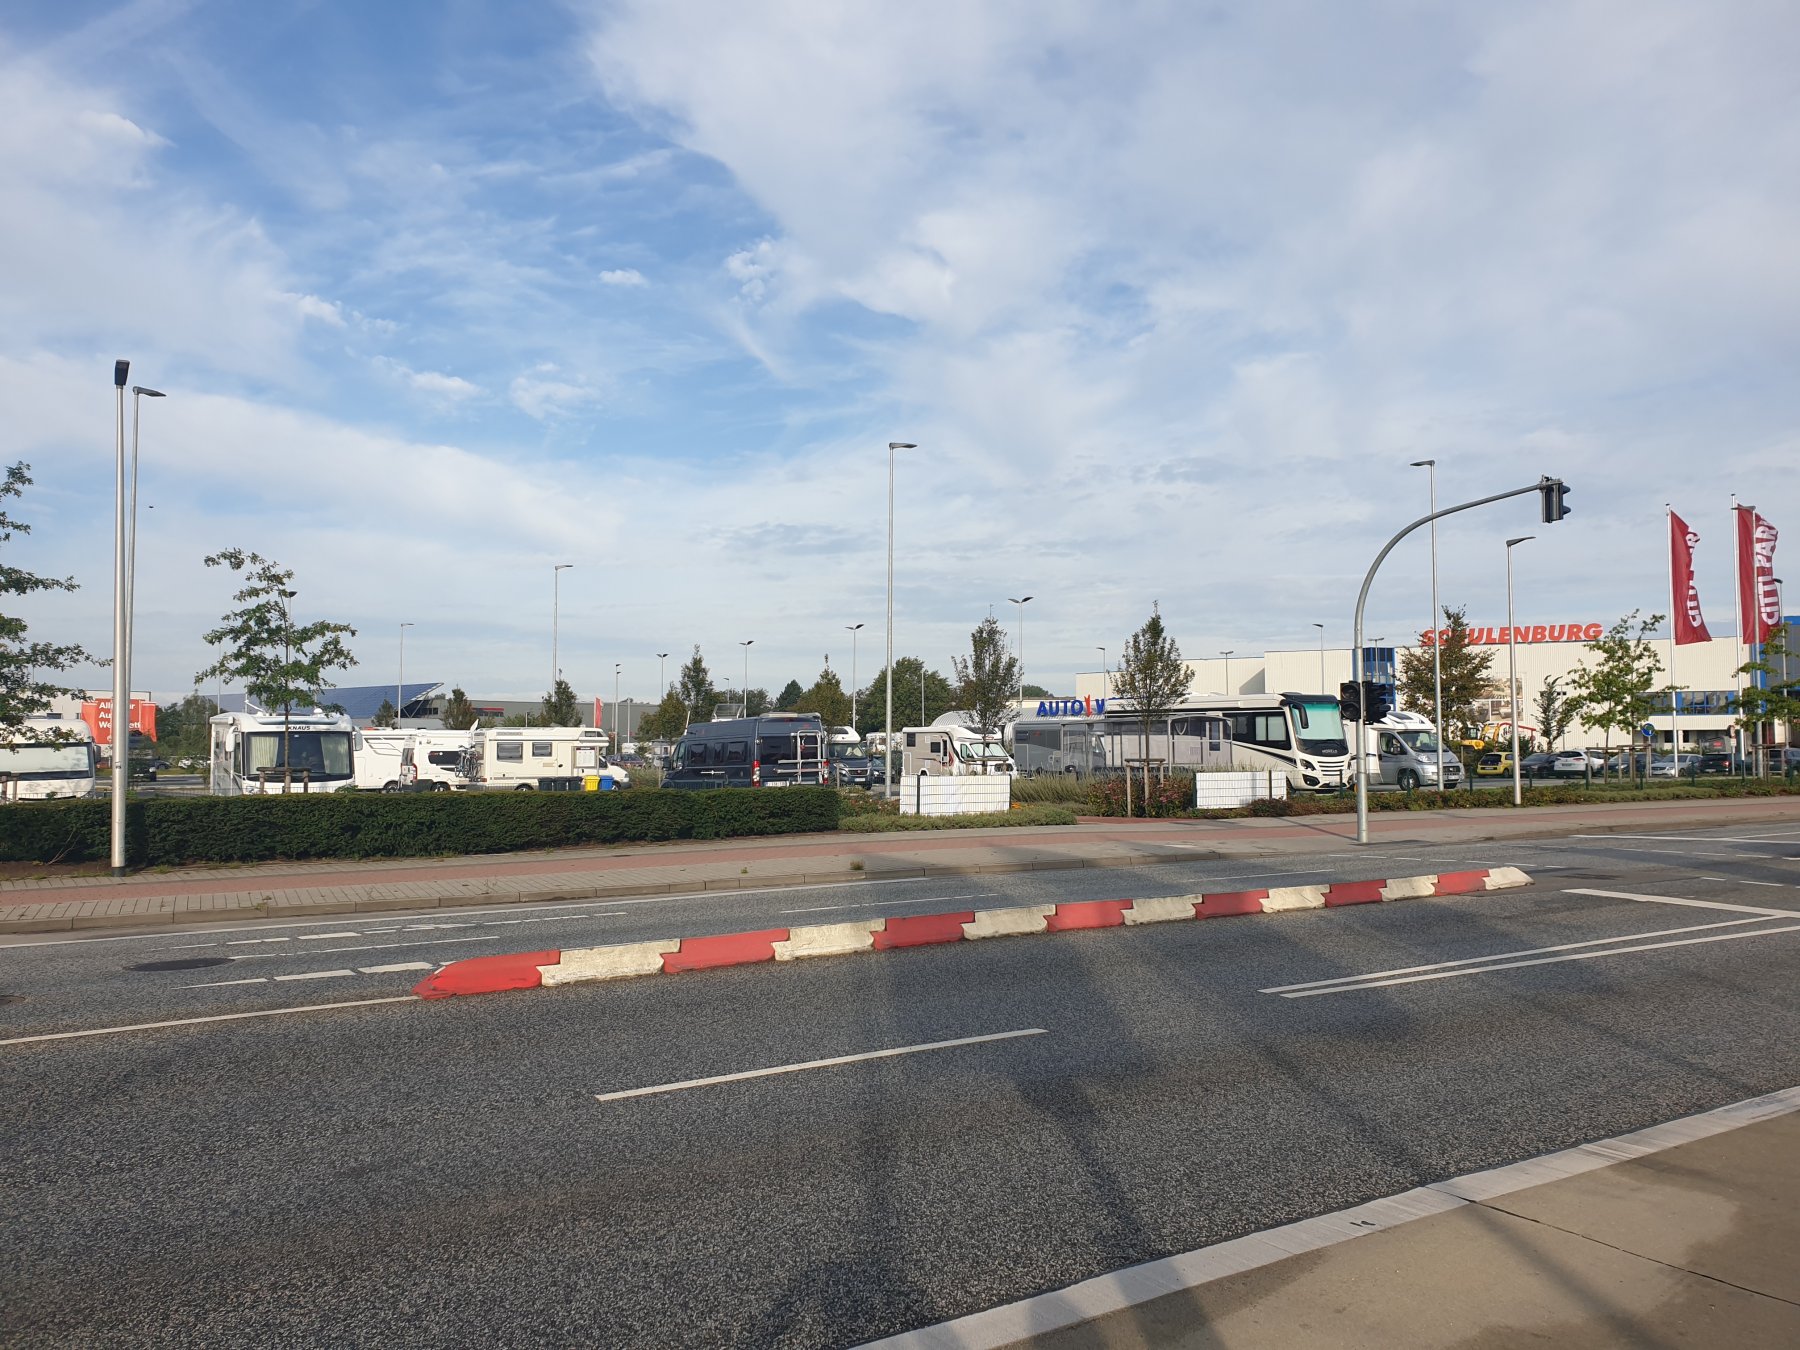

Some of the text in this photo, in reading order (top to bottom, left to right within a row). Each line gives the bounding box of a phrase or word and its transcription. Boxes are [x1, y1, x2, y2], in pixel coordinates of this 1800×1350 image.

[1757, 577, 1780, 626] CITTI
[1419, 623, 1604, 647] SCULENBURG
[1036, 700, 1084, 717] AUTO
